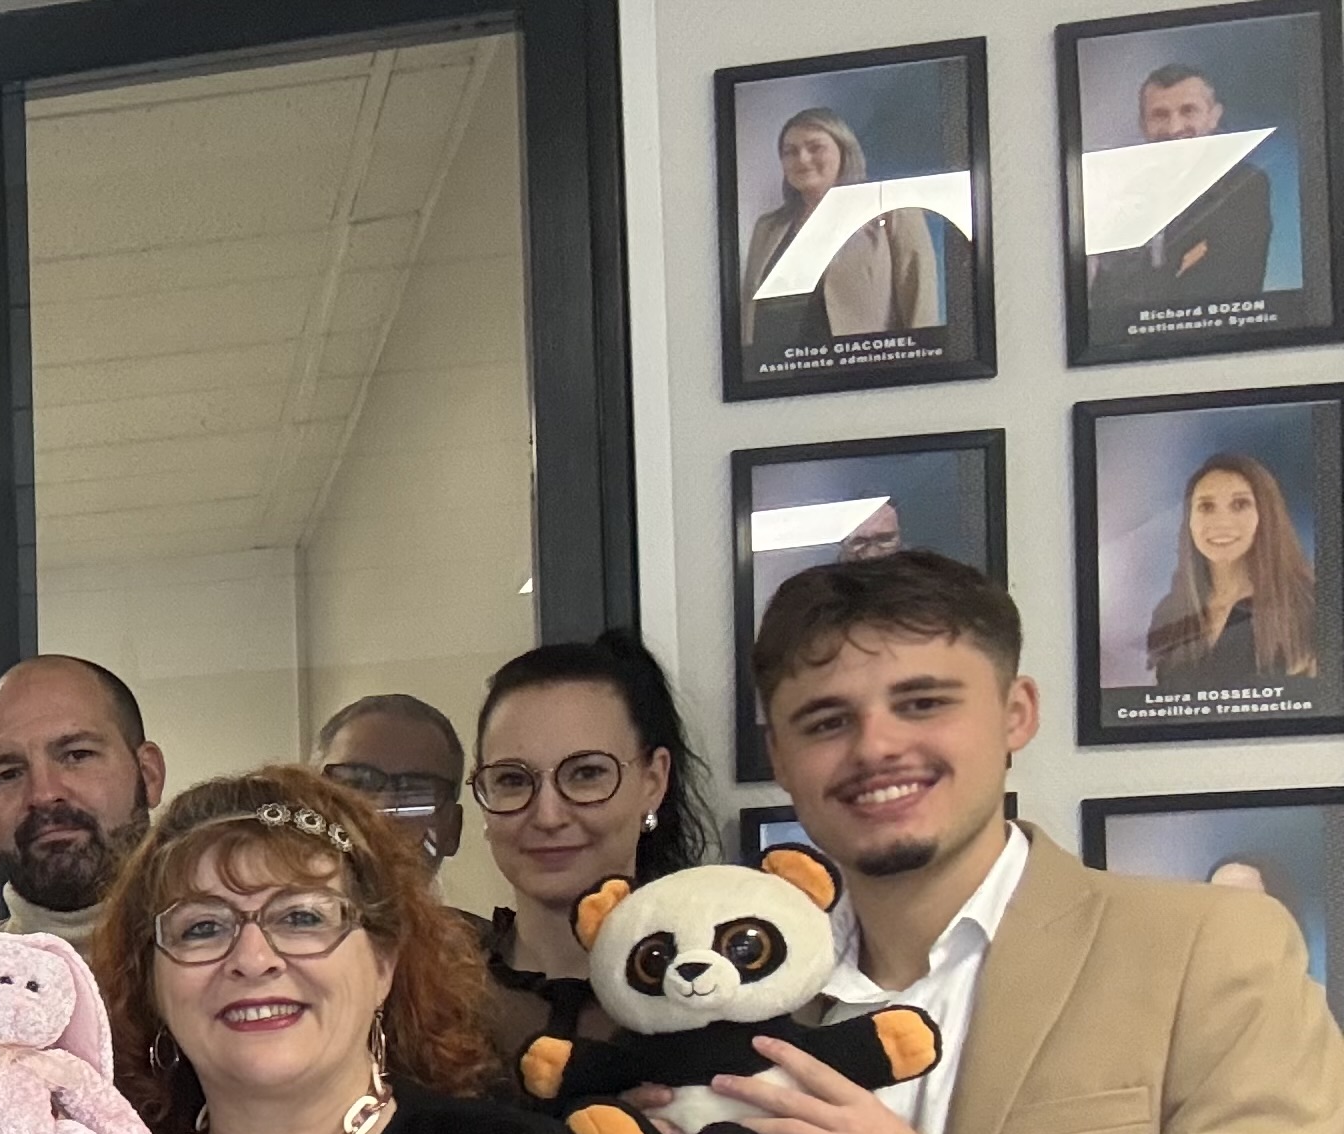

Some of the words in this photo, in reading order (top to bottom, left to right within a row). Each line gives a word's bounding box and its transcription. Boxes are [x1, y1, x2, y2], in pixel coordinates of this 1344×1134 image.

[1127, 318, 1223, 335] Gestionnaire
[1228, 312, 1278, 327] Syndic
[1139, 305, 1203, 321] Richard
[784, 345, 829, 358] Chloé
[833, 336, 917, 354] GIACOMEL
[759, 357, 835, 373] Assistante
[839, 347, 944, 366] administrative
[1145, 693, 1192, 704] Laura
[1197, 687, 1285, 701] ROSSELOT
[1117, 703, 1212, 719] Conseillère
[1216, 699, 1313, 715] transaction
